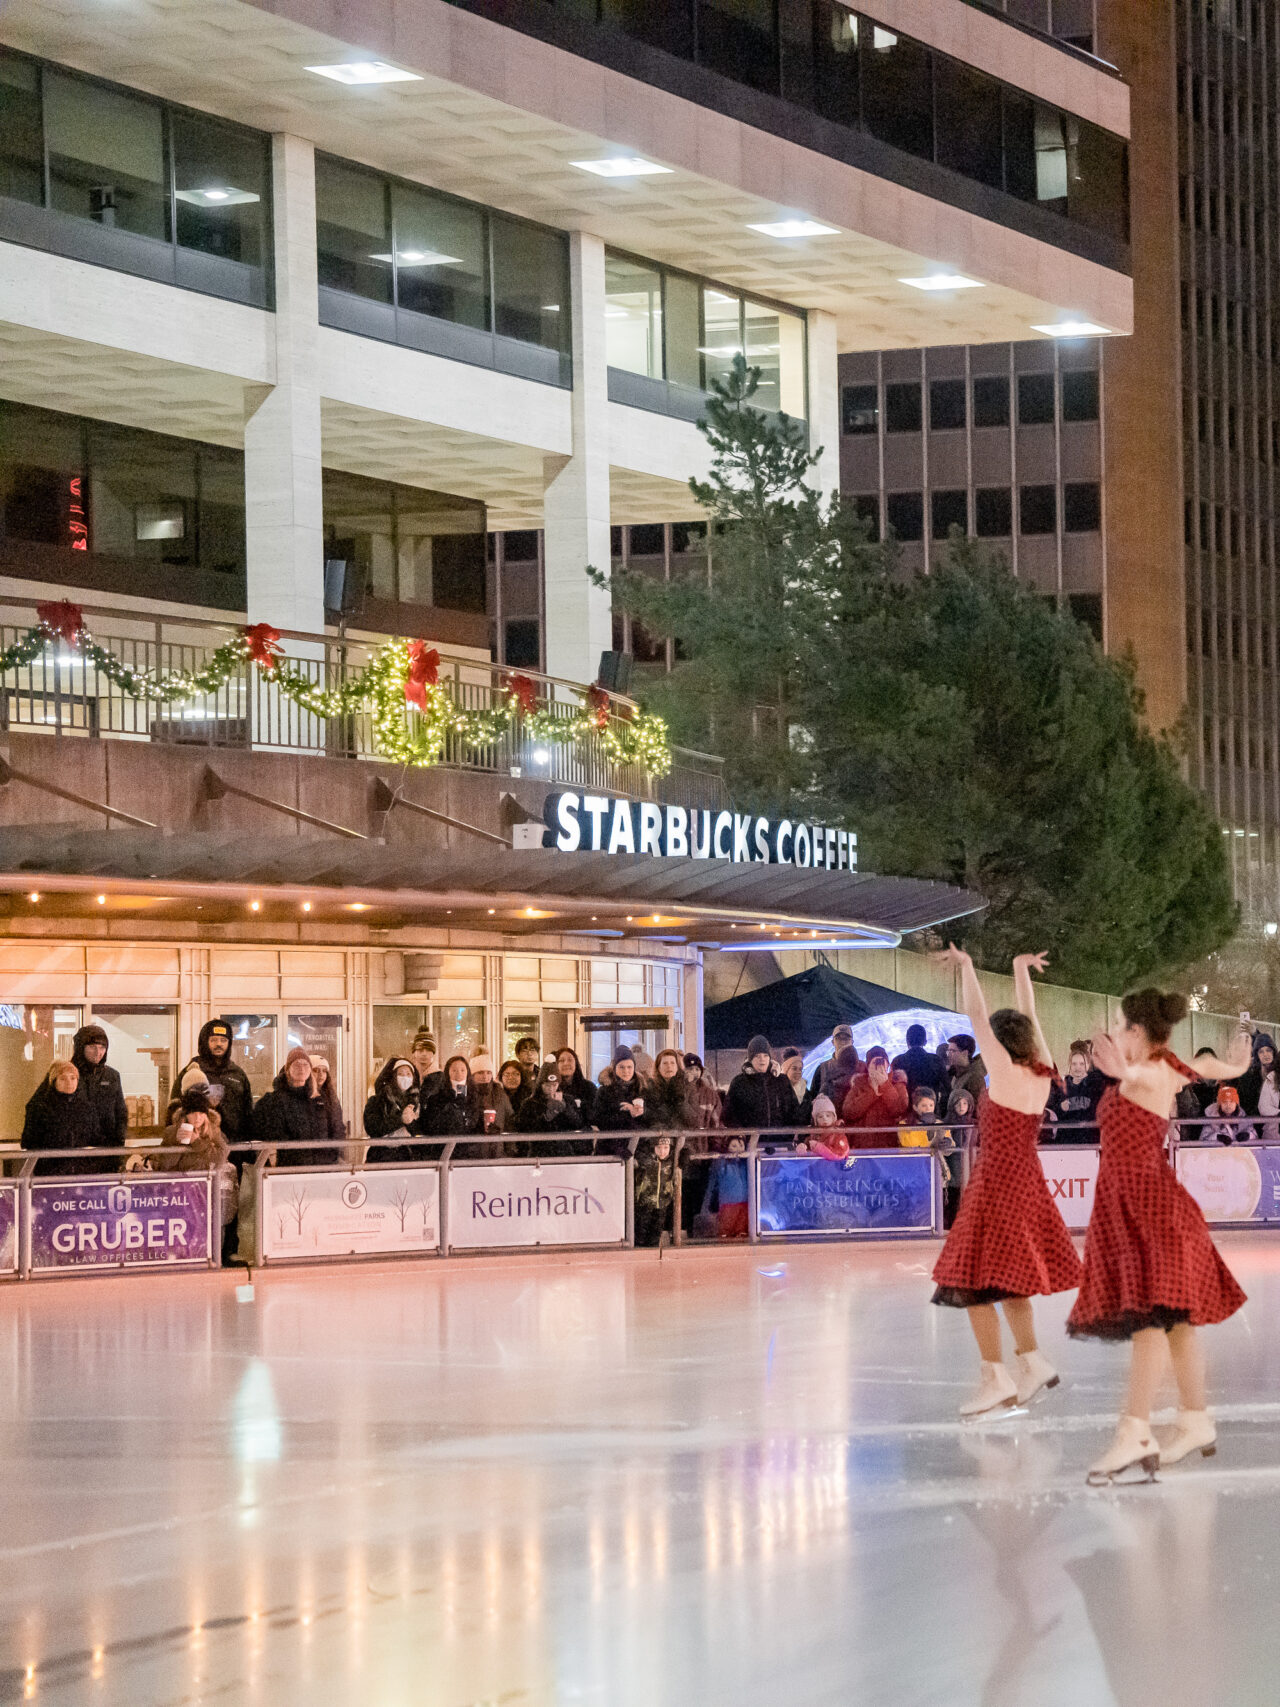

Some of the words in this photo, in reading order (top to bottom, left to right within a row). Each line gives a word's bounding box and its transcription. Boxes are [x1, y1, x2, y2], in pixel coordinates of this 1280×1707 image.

[556, 791, 769, 865] STARBUCKS
[776, 819, 858, 874] COFFEE
[786, 1178, 883, 1194] PARTNERING
[890, 1177, 907, 1191] IN
[1045, 1178, 1089, 1198] XIT
[52, 1201, 77, 1212] ONE
[78, 1200, 107, 1211] CALL
[132, 1197, 169, 1208] THAT'S
[170, 1195, 190, 1206] ALL
[472, 1186, 591, 1219] Reinhart
[793, 1193, 899, 1209] POSSIBILITIES
[364, 1212, 386, 1220] PARKS
[52, 1218, 188, 1253] GRUBER
[75, 1255, 97, 1264] LAW
[101, 1252, 144, 1262] OFFICES
[148, 1251, 167, 1260] LLC
